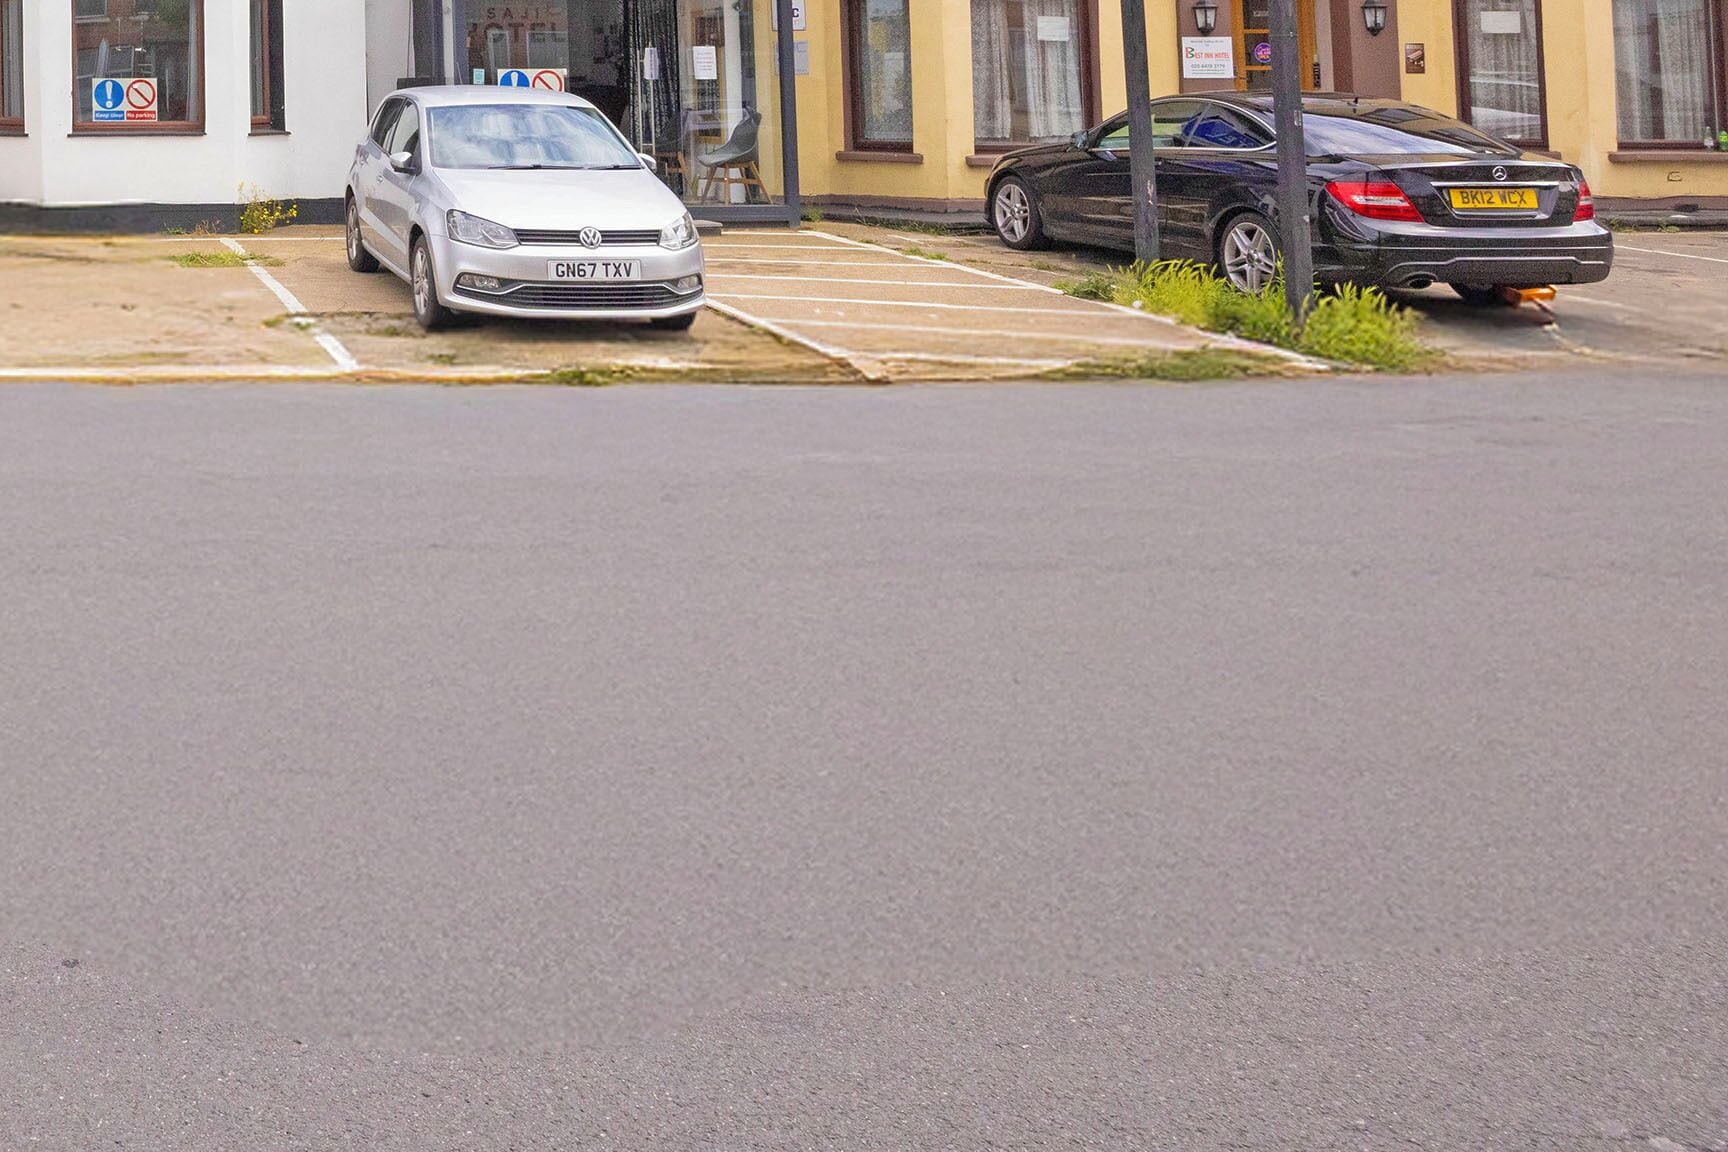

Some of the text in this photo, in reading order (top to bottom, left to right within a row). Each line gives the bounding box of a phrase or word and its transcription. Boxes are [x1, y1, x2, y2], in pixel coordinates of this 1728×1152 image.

[1460, 191, 1495, 204] BK12
[556, 263, 632, 277] GN67 TXV
